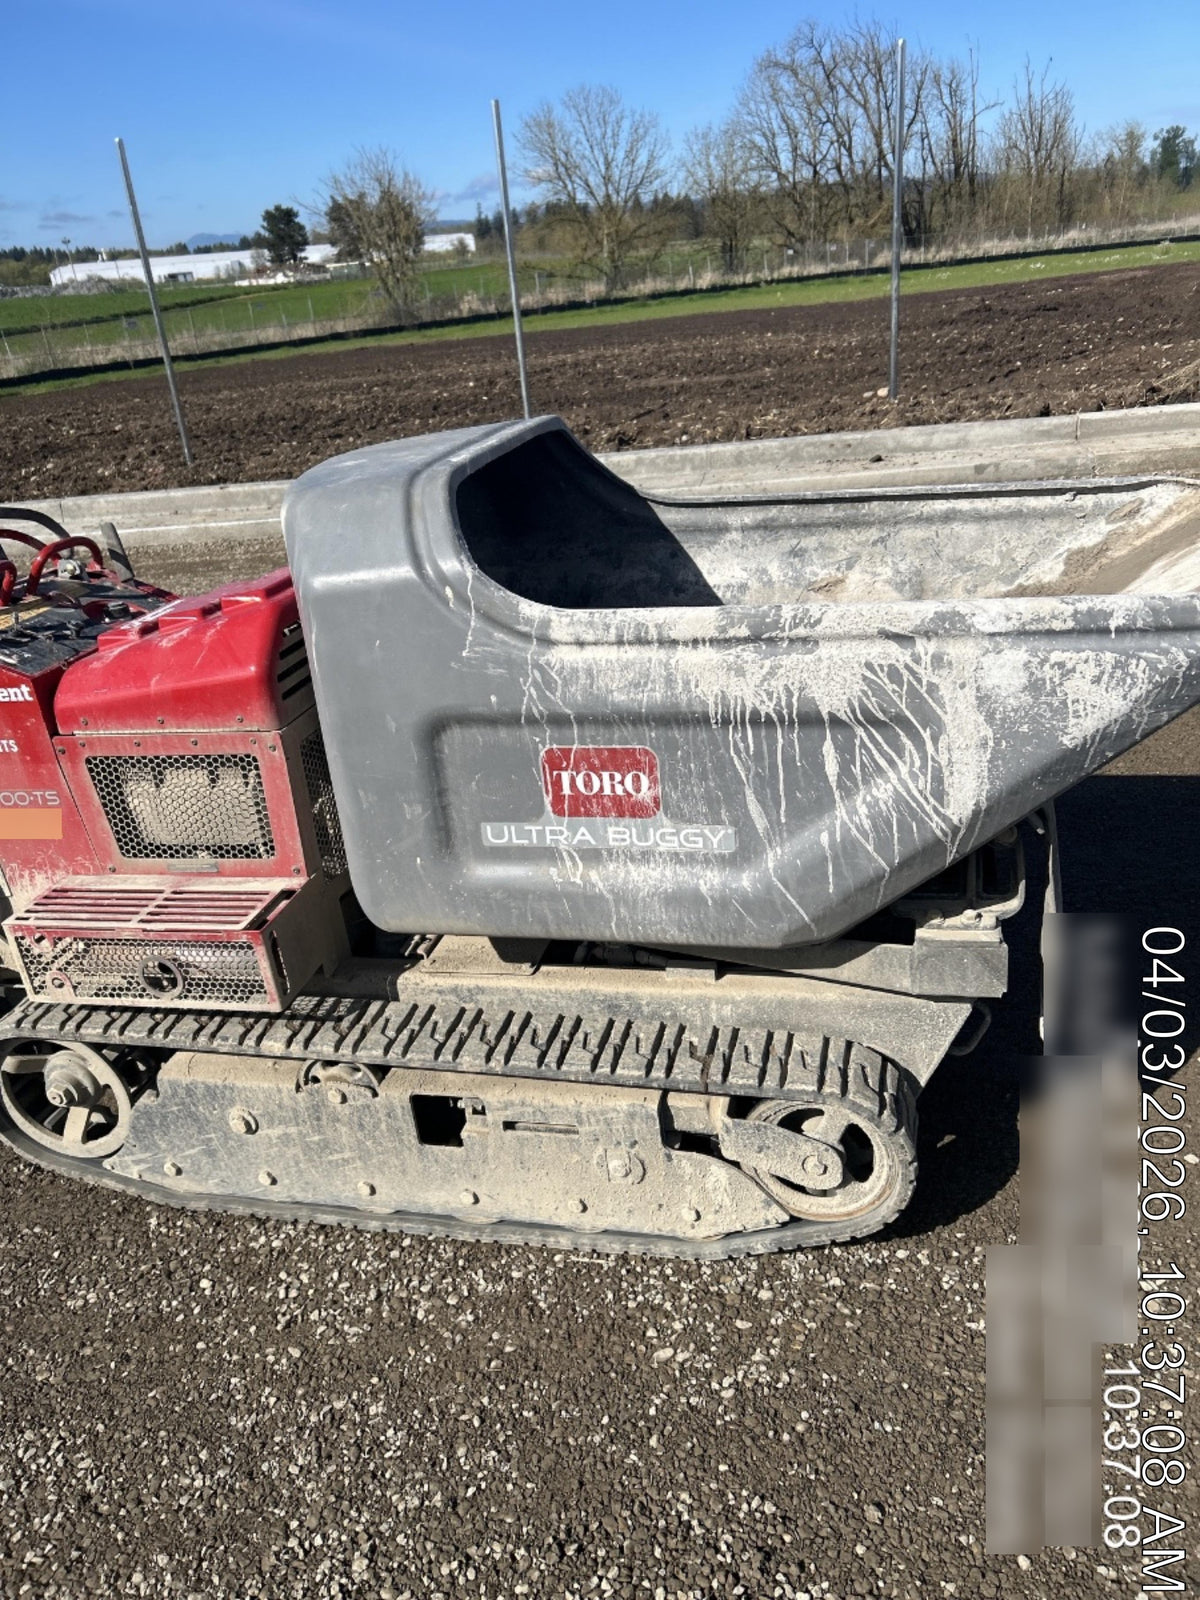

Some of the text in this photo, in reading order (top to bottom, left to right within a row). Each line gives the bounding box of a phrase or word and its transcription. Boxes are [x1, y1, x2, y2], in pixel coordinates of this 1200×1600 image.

[0, 739, 19, 753] TS
[553, 770, 649, 796] TORO
[486, 825, 728, 849] ULTRA BUGGY
